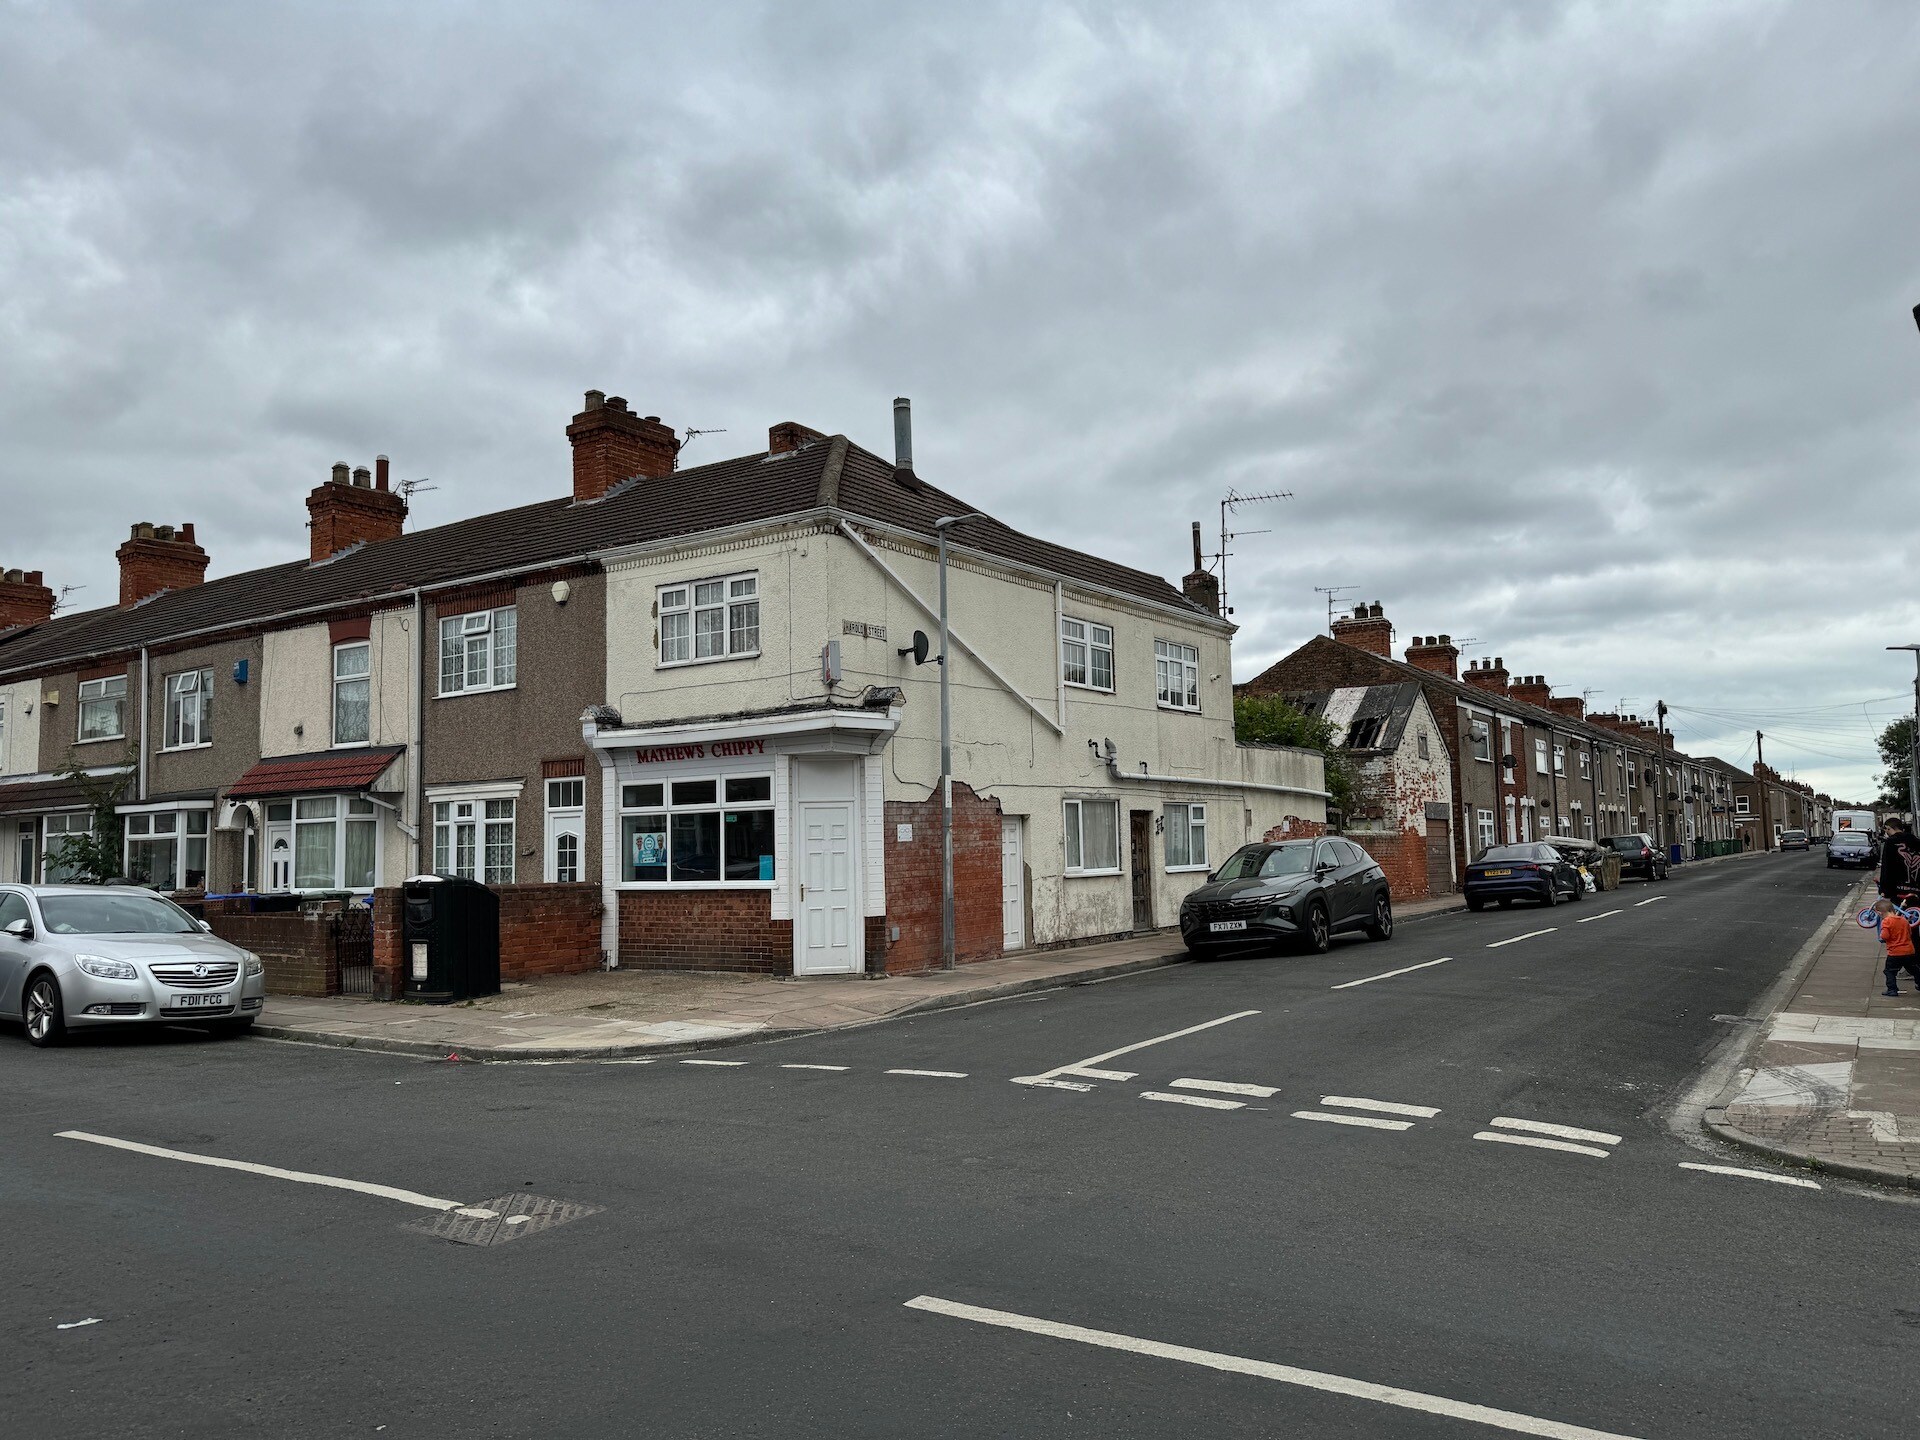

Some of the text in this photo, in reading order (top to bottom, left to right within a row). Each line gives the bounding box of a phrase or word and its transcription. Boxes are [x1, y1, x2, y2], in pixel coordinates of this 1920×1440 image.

[868, 625, 885, 638] STREET
[635, 740, 765, 763] MATHEWS CHIPPY
[1213, 922, 1228, 931] FX71
[180, 994, 222, 1006] FD11 FCG
